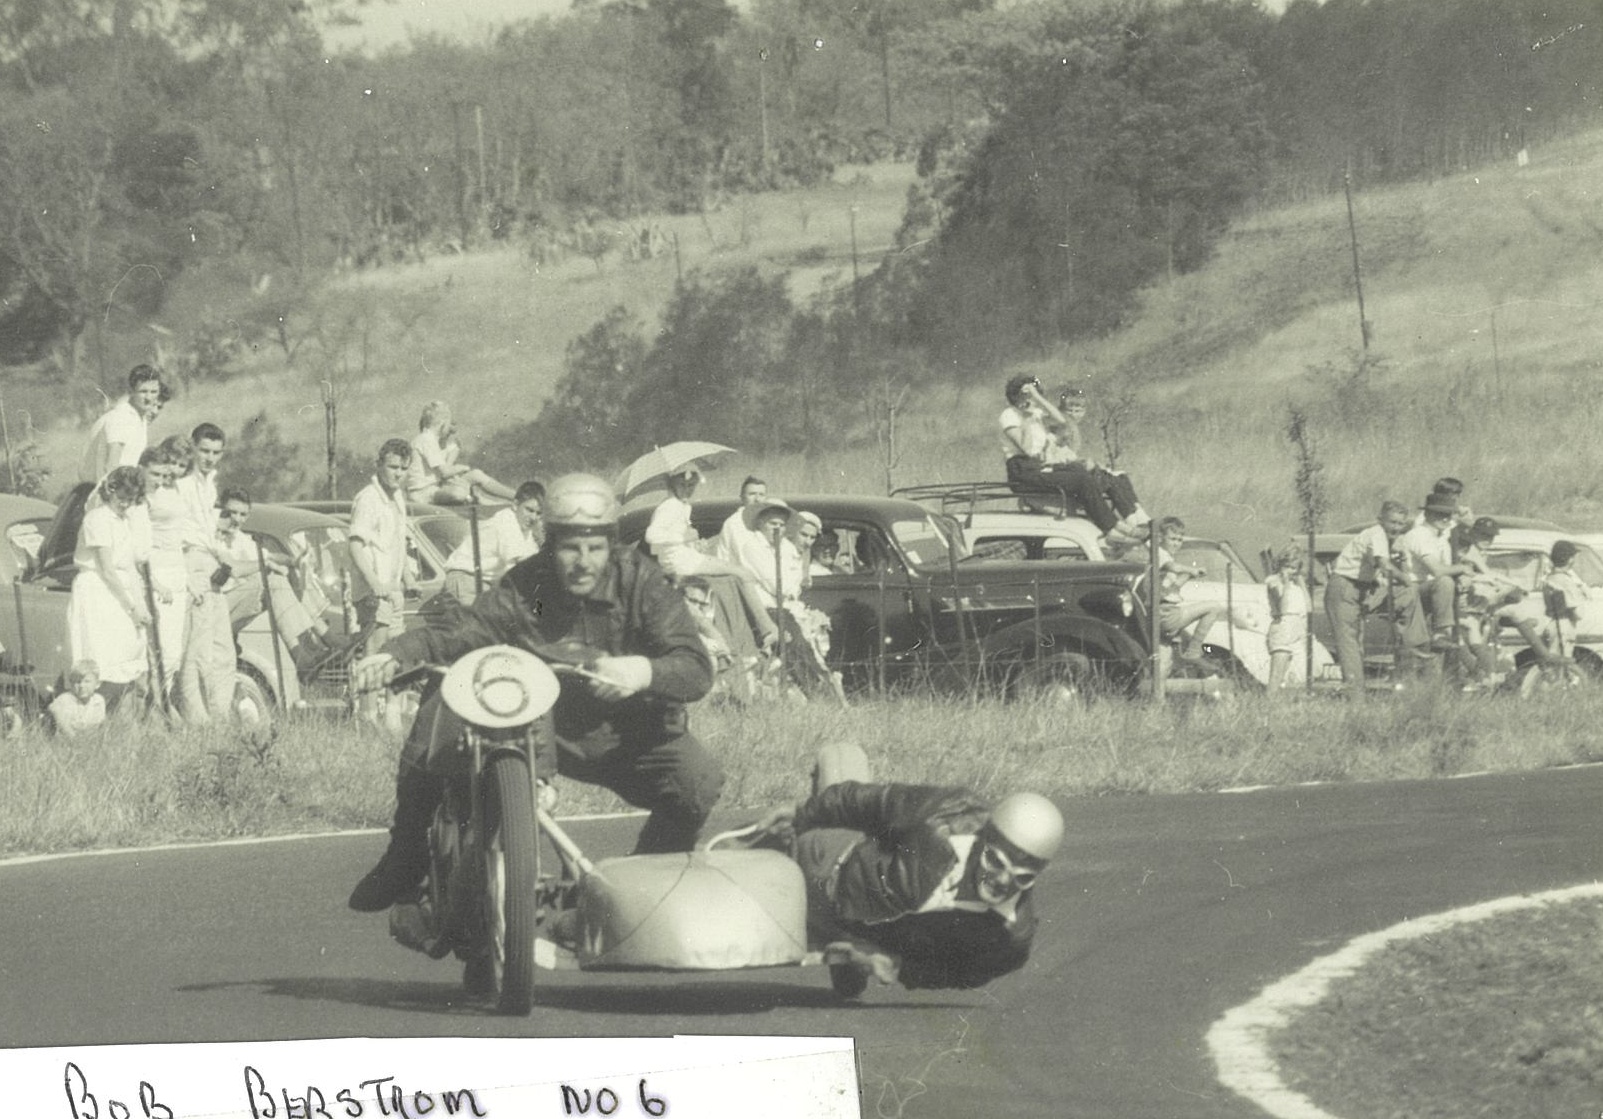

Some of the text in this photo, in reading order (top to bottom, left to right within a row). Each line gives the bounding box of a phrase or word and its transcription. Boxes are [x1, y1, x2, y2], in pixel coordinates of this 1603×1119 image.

[473, 652, 530, 718] 6
[560, 1084, 618, 1115] NO
[639, 1079, 665, 1116] 6
